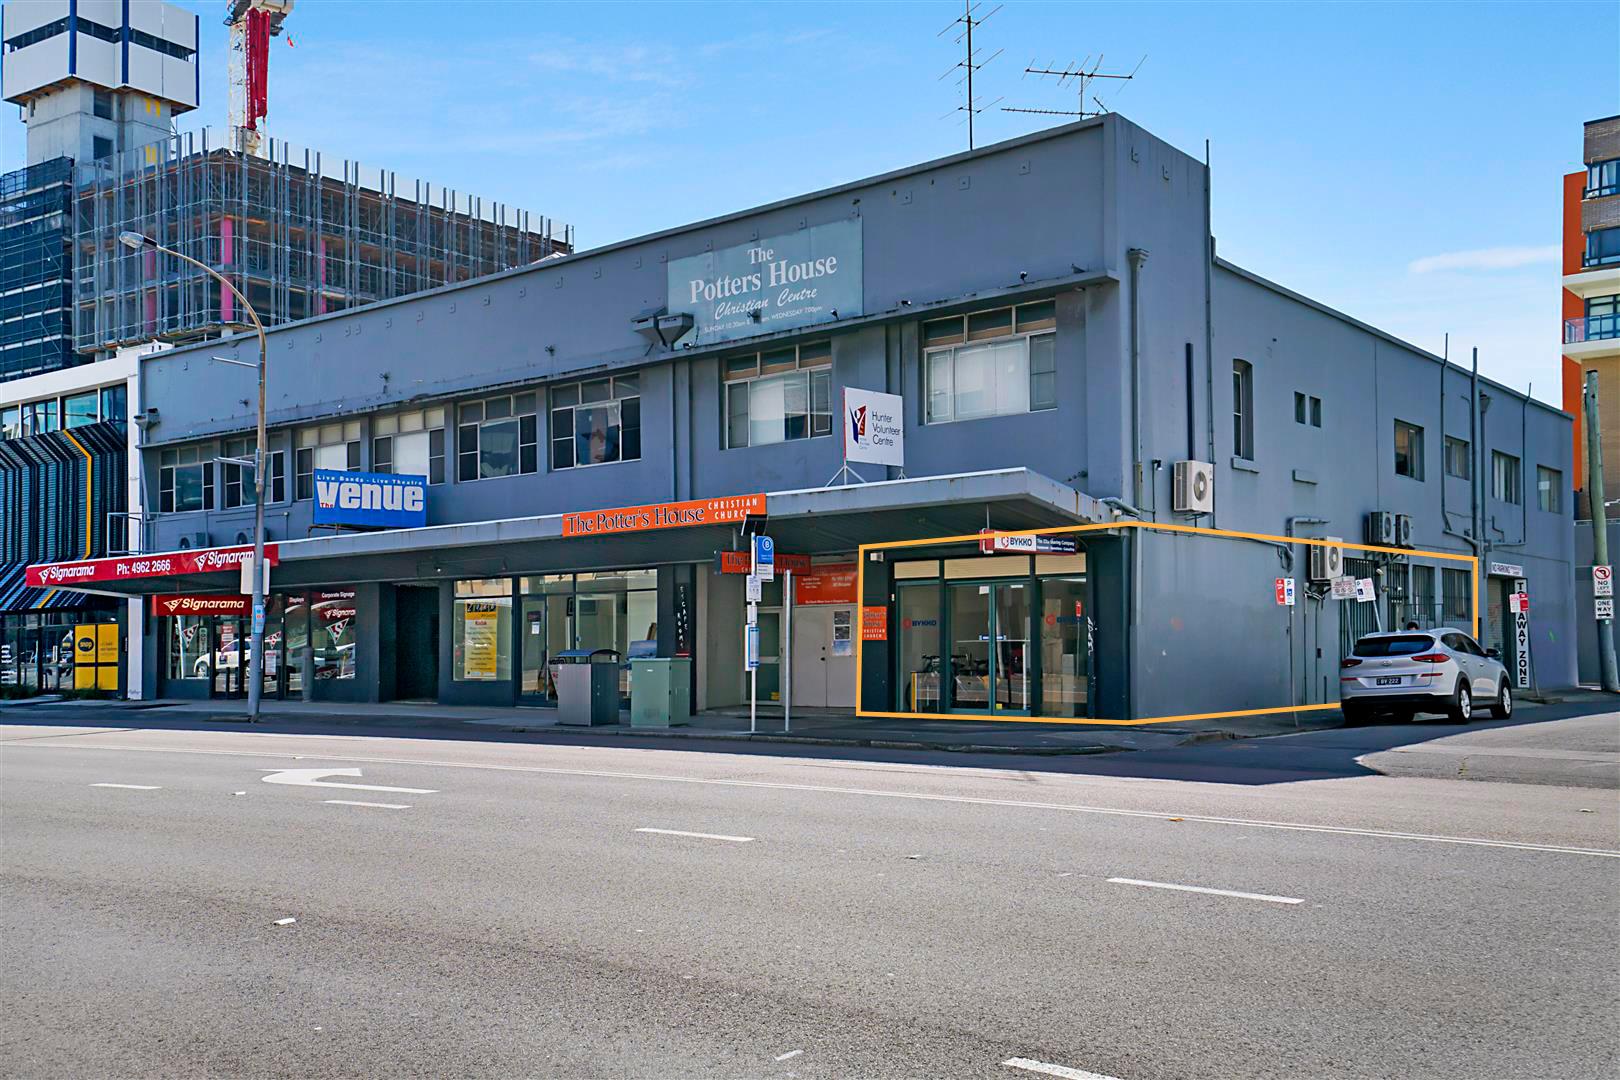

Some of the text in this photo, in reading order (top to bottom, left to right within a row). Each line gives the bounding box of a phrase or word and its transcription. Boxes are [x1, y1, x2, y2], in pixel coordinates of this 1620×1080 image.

[747, 248, 774, 265] The
[689, 255, 837, 304] Potters House
[714, 286, 818, 320] Christian Centre
[871, 410, 894, 423] Hunter
[871, 422, 902, 436] Volunteer
[872, 434, 894, 447] Centre
[707, 497, 758, 511] CHRISTIAN
[567, 507, 705, 534] The Potter's House
[1009, 536, 1033, 547] BYKKO
[49, 550, 255, 581] Signarama Ph: 4962 2666 Signaram
[181, 597, 245, 611] Signarama
[1516, 612, 1528, 647] AWAY
[1518, 650, 1528, 686] ZONE
